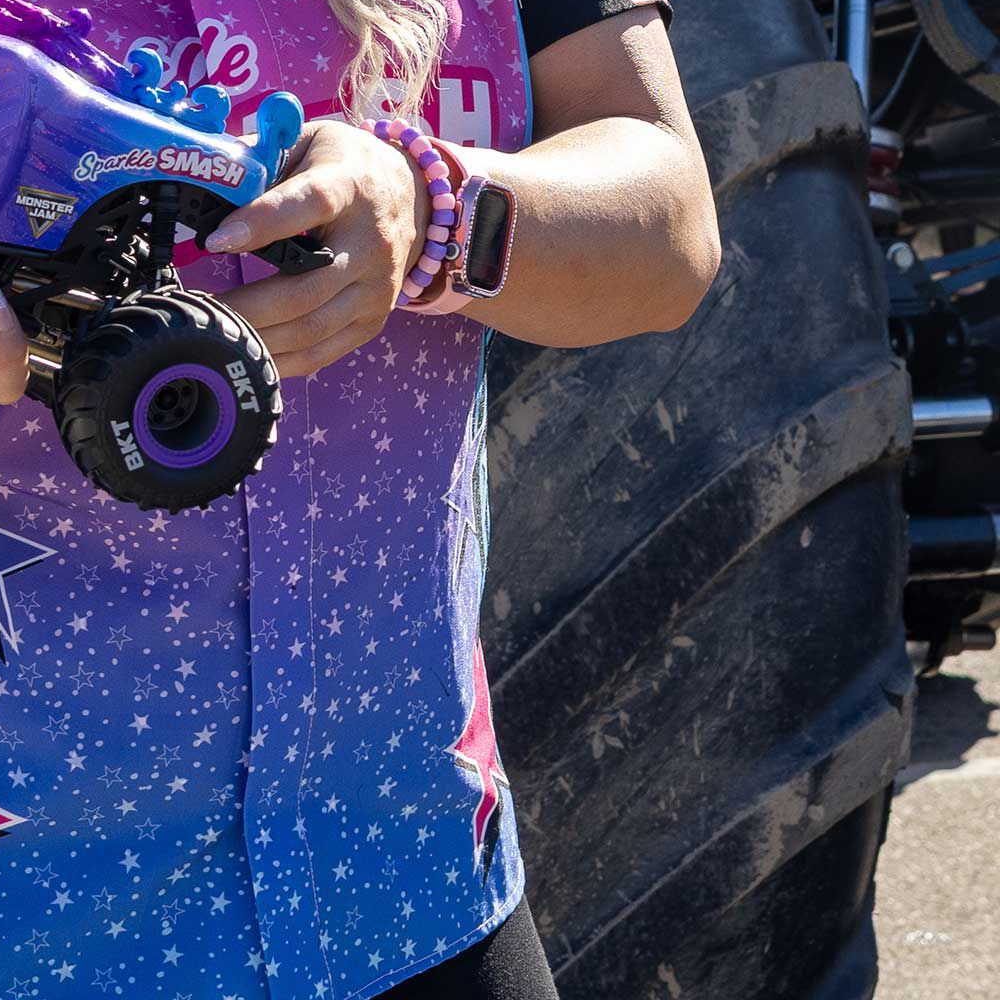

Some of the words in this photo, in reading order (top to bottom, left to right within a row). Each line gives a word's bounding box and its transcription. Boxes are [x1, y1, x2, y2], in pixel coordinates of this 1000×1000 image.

[74, 148, 156, 182] Sparkle
[158, 147, 245, 186] SMASH
[16, 194, 74, 214] MONSTER
[29, 208, 56, 220] JAM
[225, 360, 260, 413] BKT
[110, 420, 144, 471] BKT
